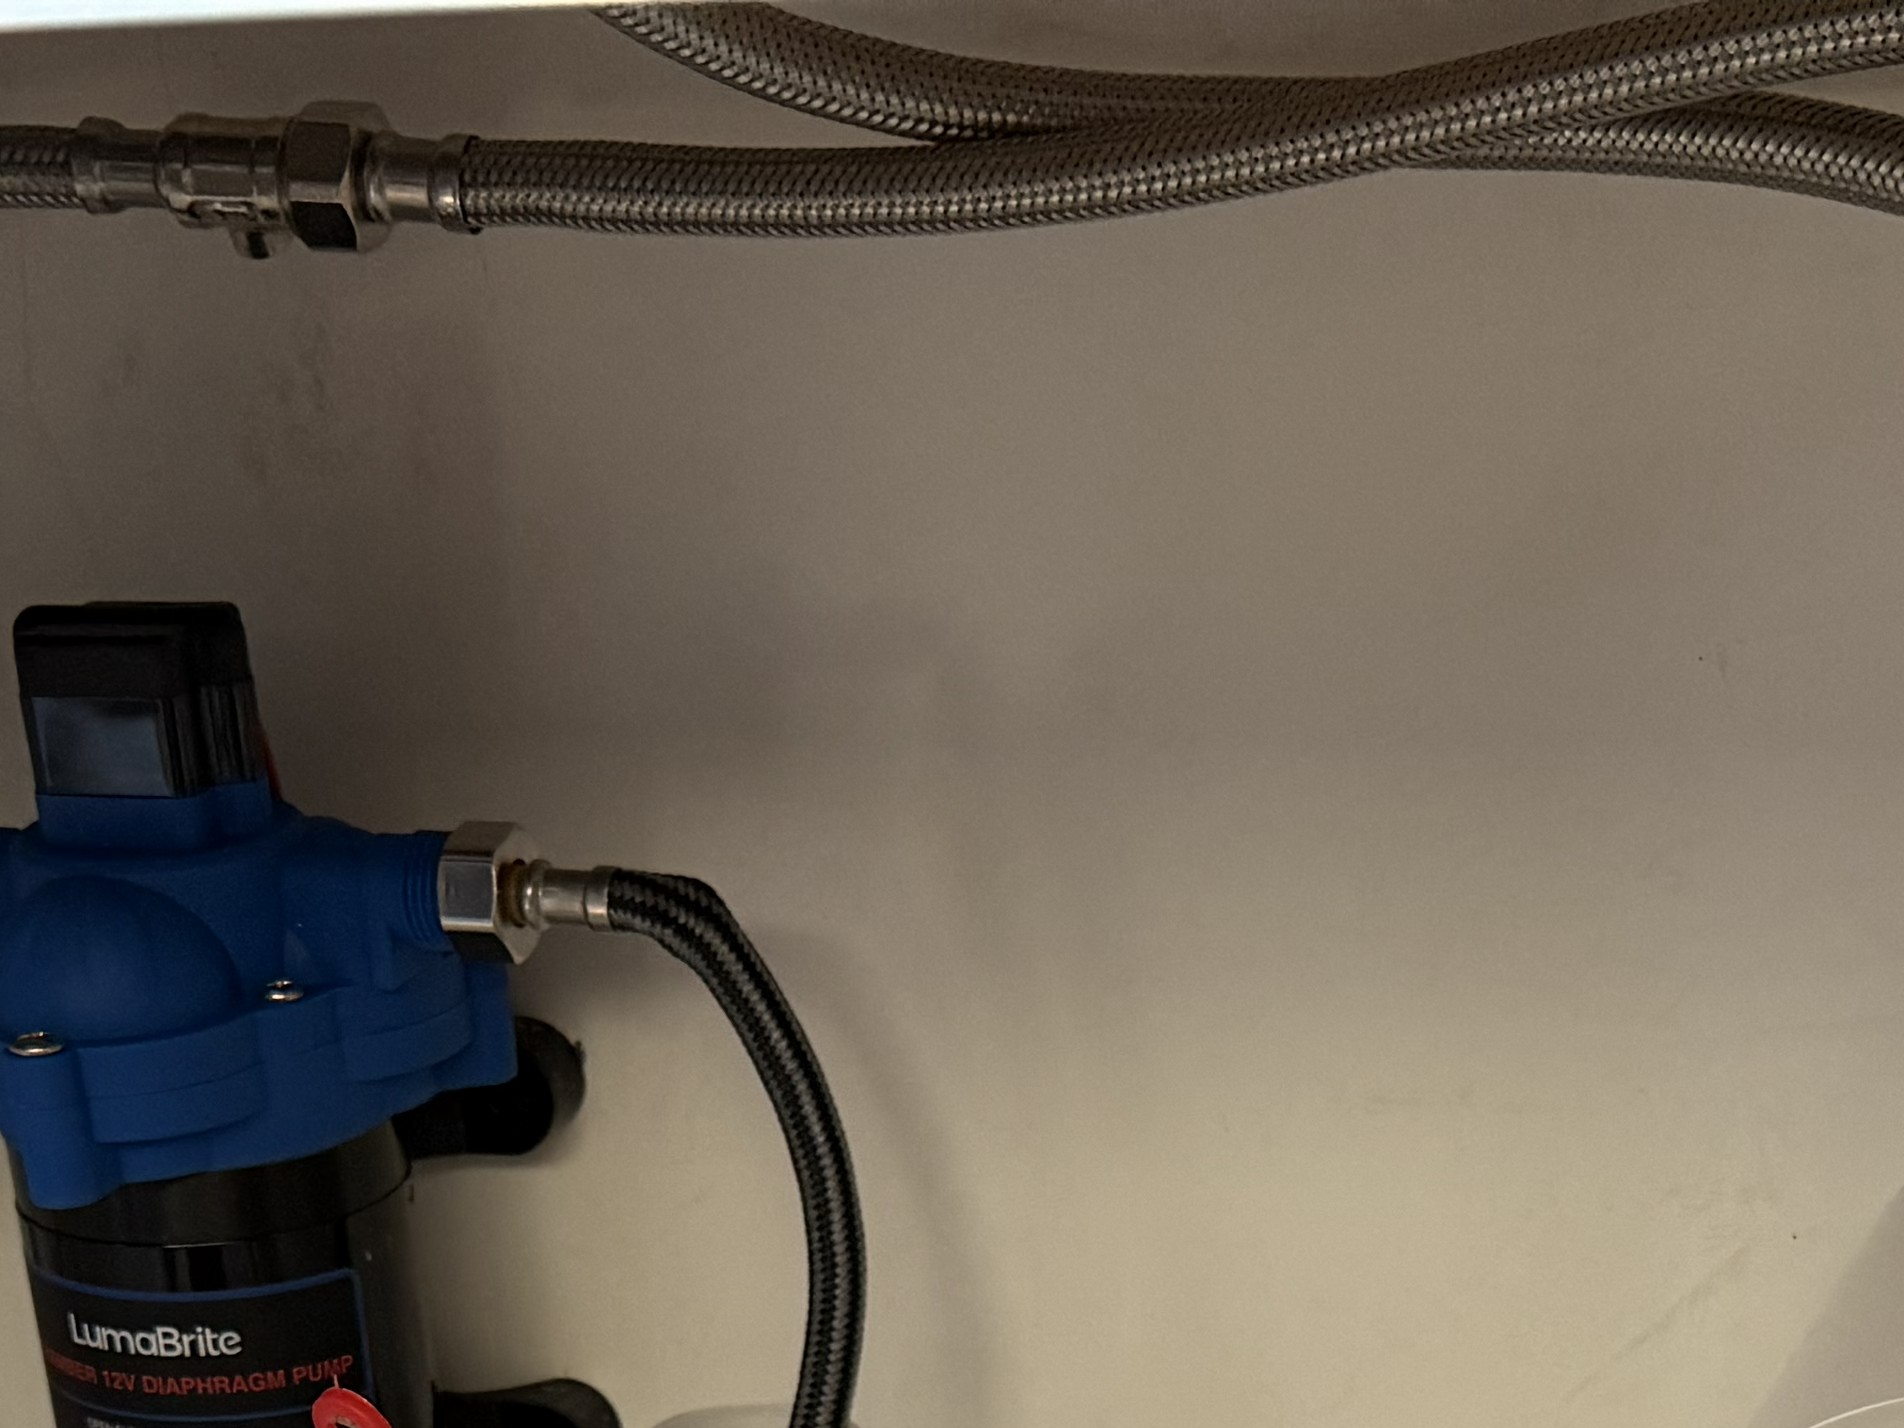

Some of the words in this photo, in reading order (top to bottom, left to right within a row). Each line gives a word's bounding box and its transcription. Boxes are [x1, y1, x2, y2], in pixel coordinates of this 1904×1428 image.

[67, 1311, 243, 1358] LumaBrite
[102, 1369, 136, 1393] 12V
[141, 1369, 286, 1396] DIAPHRAGM
[291, 1354, 355, 1385] PUMP
